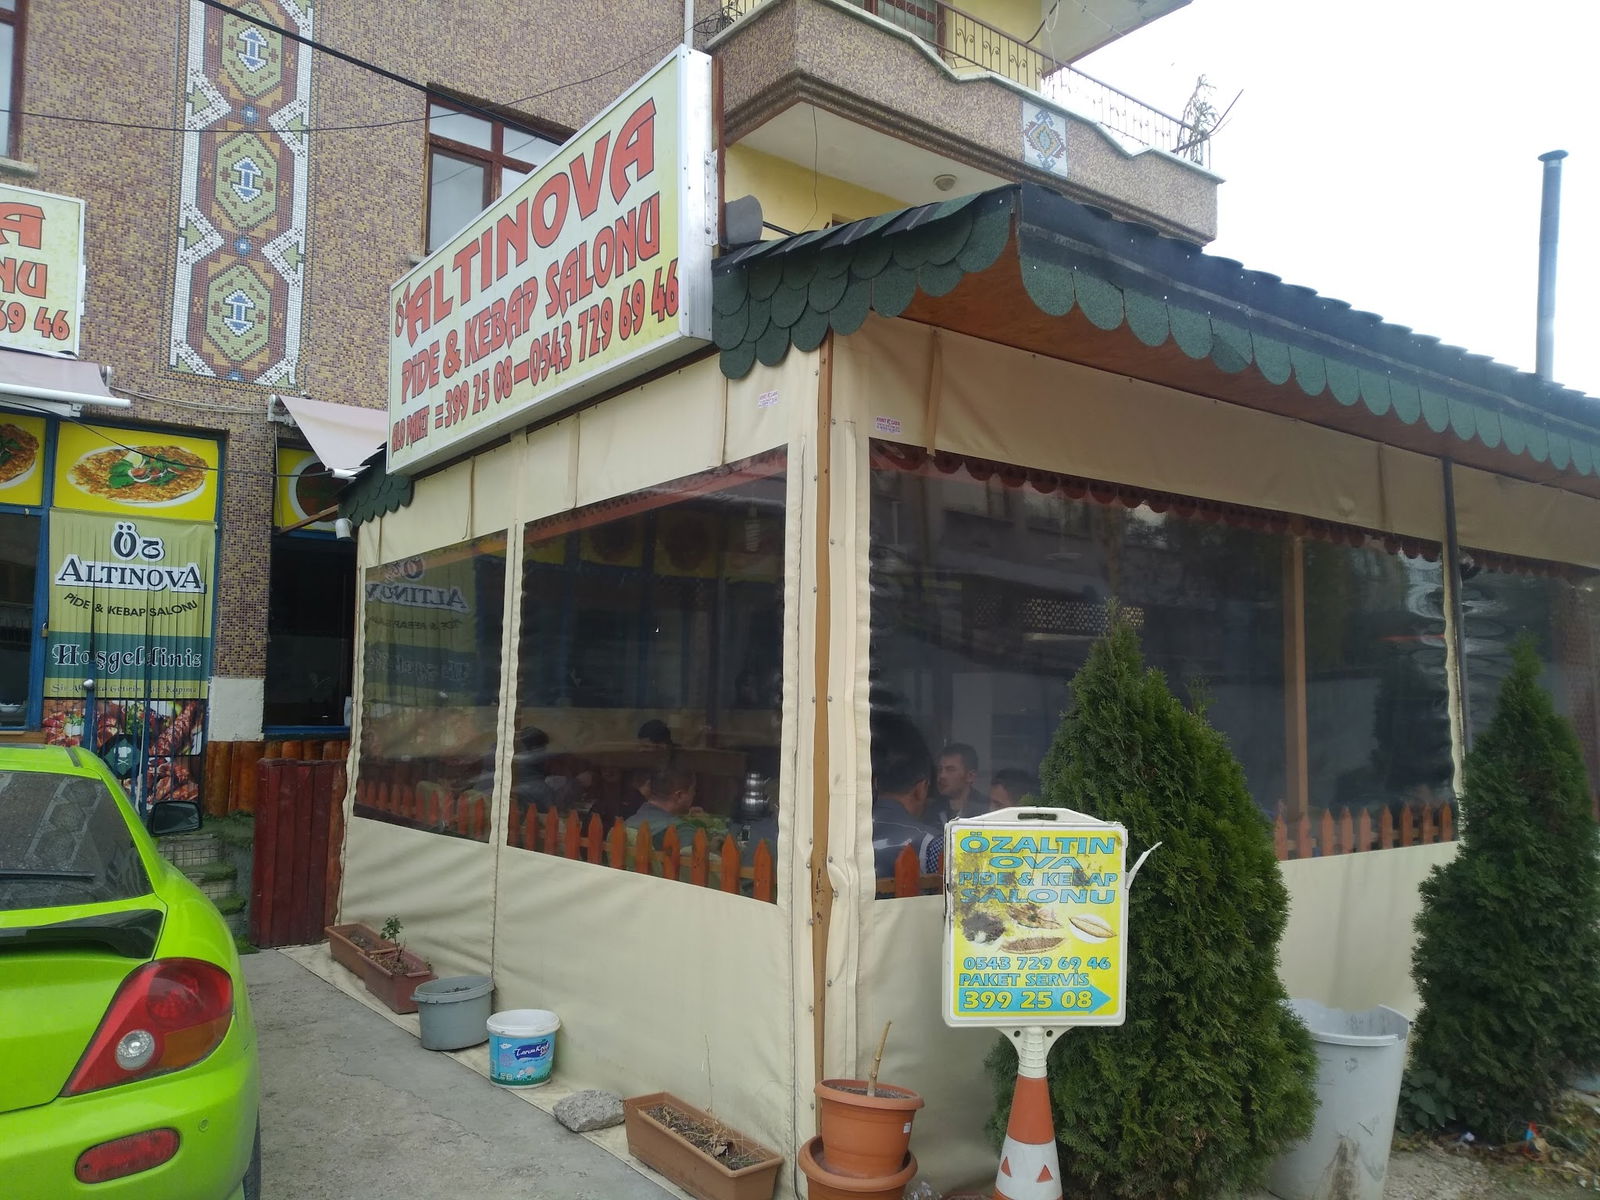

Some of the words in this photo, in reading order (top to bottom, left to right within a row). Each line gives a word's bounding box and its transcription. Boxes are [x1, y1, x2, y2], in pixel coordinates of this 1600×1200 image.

[406, 97, 656, 347] ALTINOVA
[443, 329, 462, 379] &
[464, 276, 538, 367] KEBAP
[545, 192, 660, 319] SALONU
[34, 306, 70, 341] 46
[472, 372, 490, 416] 25
[578, 301, 613, 363] 729
[619, 277, 646, 341] 69
[651, 257, 679, 322] 46
[58, 557, 202, 589] ALTINOVA
[94, 603, 104, 614] &
[107, 605, 146, 617] KEBAP
[149, 600, 198, 617] SALONU
[960, 831, 1115, 854] ÖZALTIN
[989, 855, 1083, 869] OVA
[1018, 872, 1035, 887] &
[960, 888, 1116, 904] SALONU
[963, 957, 1011, 970] 0543
[1017, 957, 1053, 970] 729
[1058, 957, 1081, 970] 69
[1087, 957, 1111, 970] 46
[959, 973, 1020, 986] PAKET
[1025, 970, 1089, 986] SERVİS
[963, 990, 1013, 1009] 399
[1020, 990, 1053, 1009] 25
[1061, 990, 1092, 1009] 08
